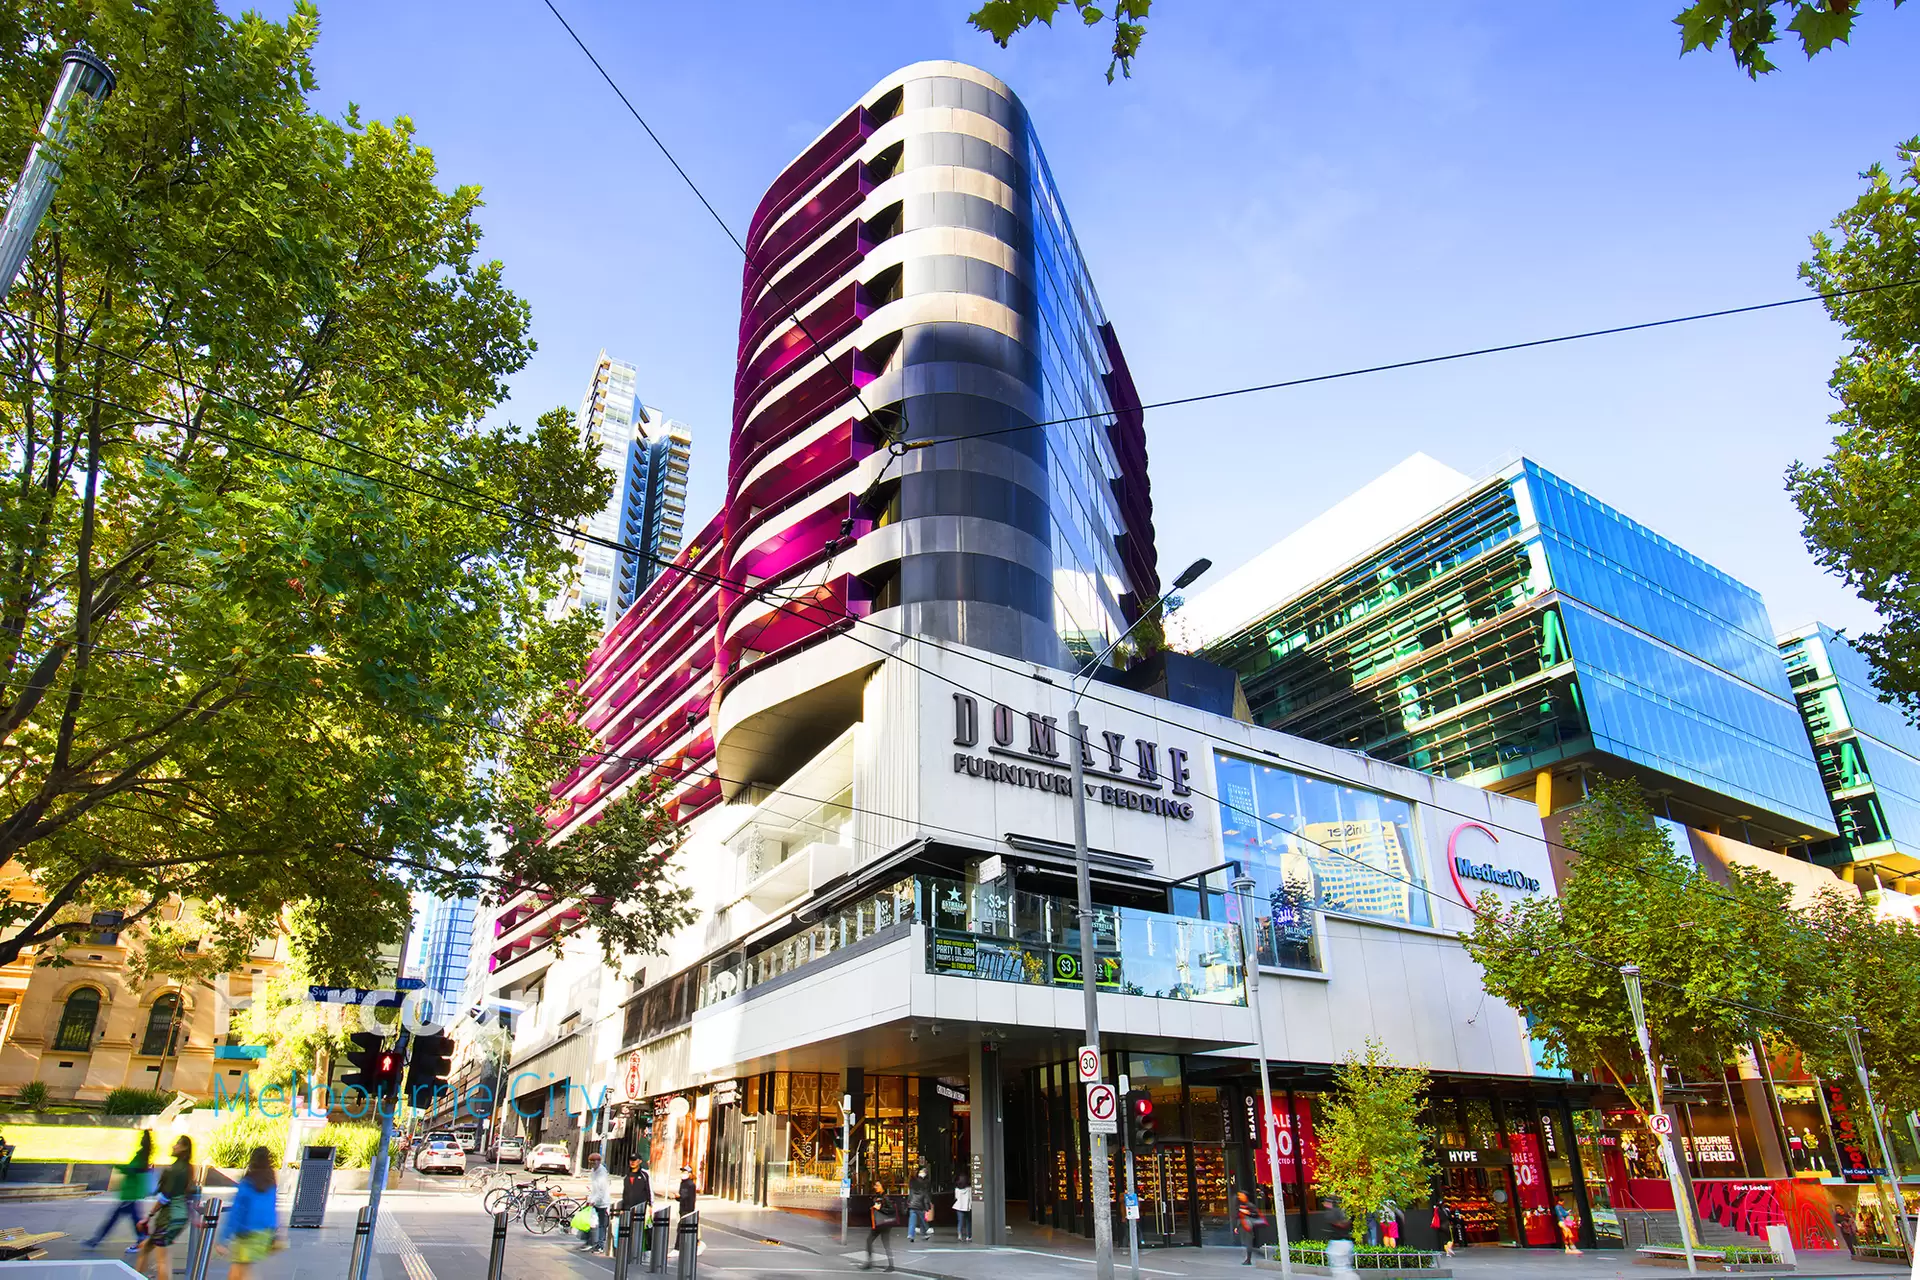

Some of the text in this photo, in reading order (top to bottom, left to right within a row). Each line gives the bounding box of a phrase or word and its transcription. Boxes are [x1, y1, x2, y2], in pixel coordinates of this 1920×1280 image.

[953, 752, 1194, 821] FURNITUR BEDDING
[1455, 857, 1540, 892] MedicalOne
[936, 944, 954, 955] PARTY
[1083, 1057, 1095, 1070] 30
[1247, 1107, 1257, 1140] HYPE
[1544, 1124, 1556, 1152] HYPE
[1449, 1151, 1478, 1162] HYPE
